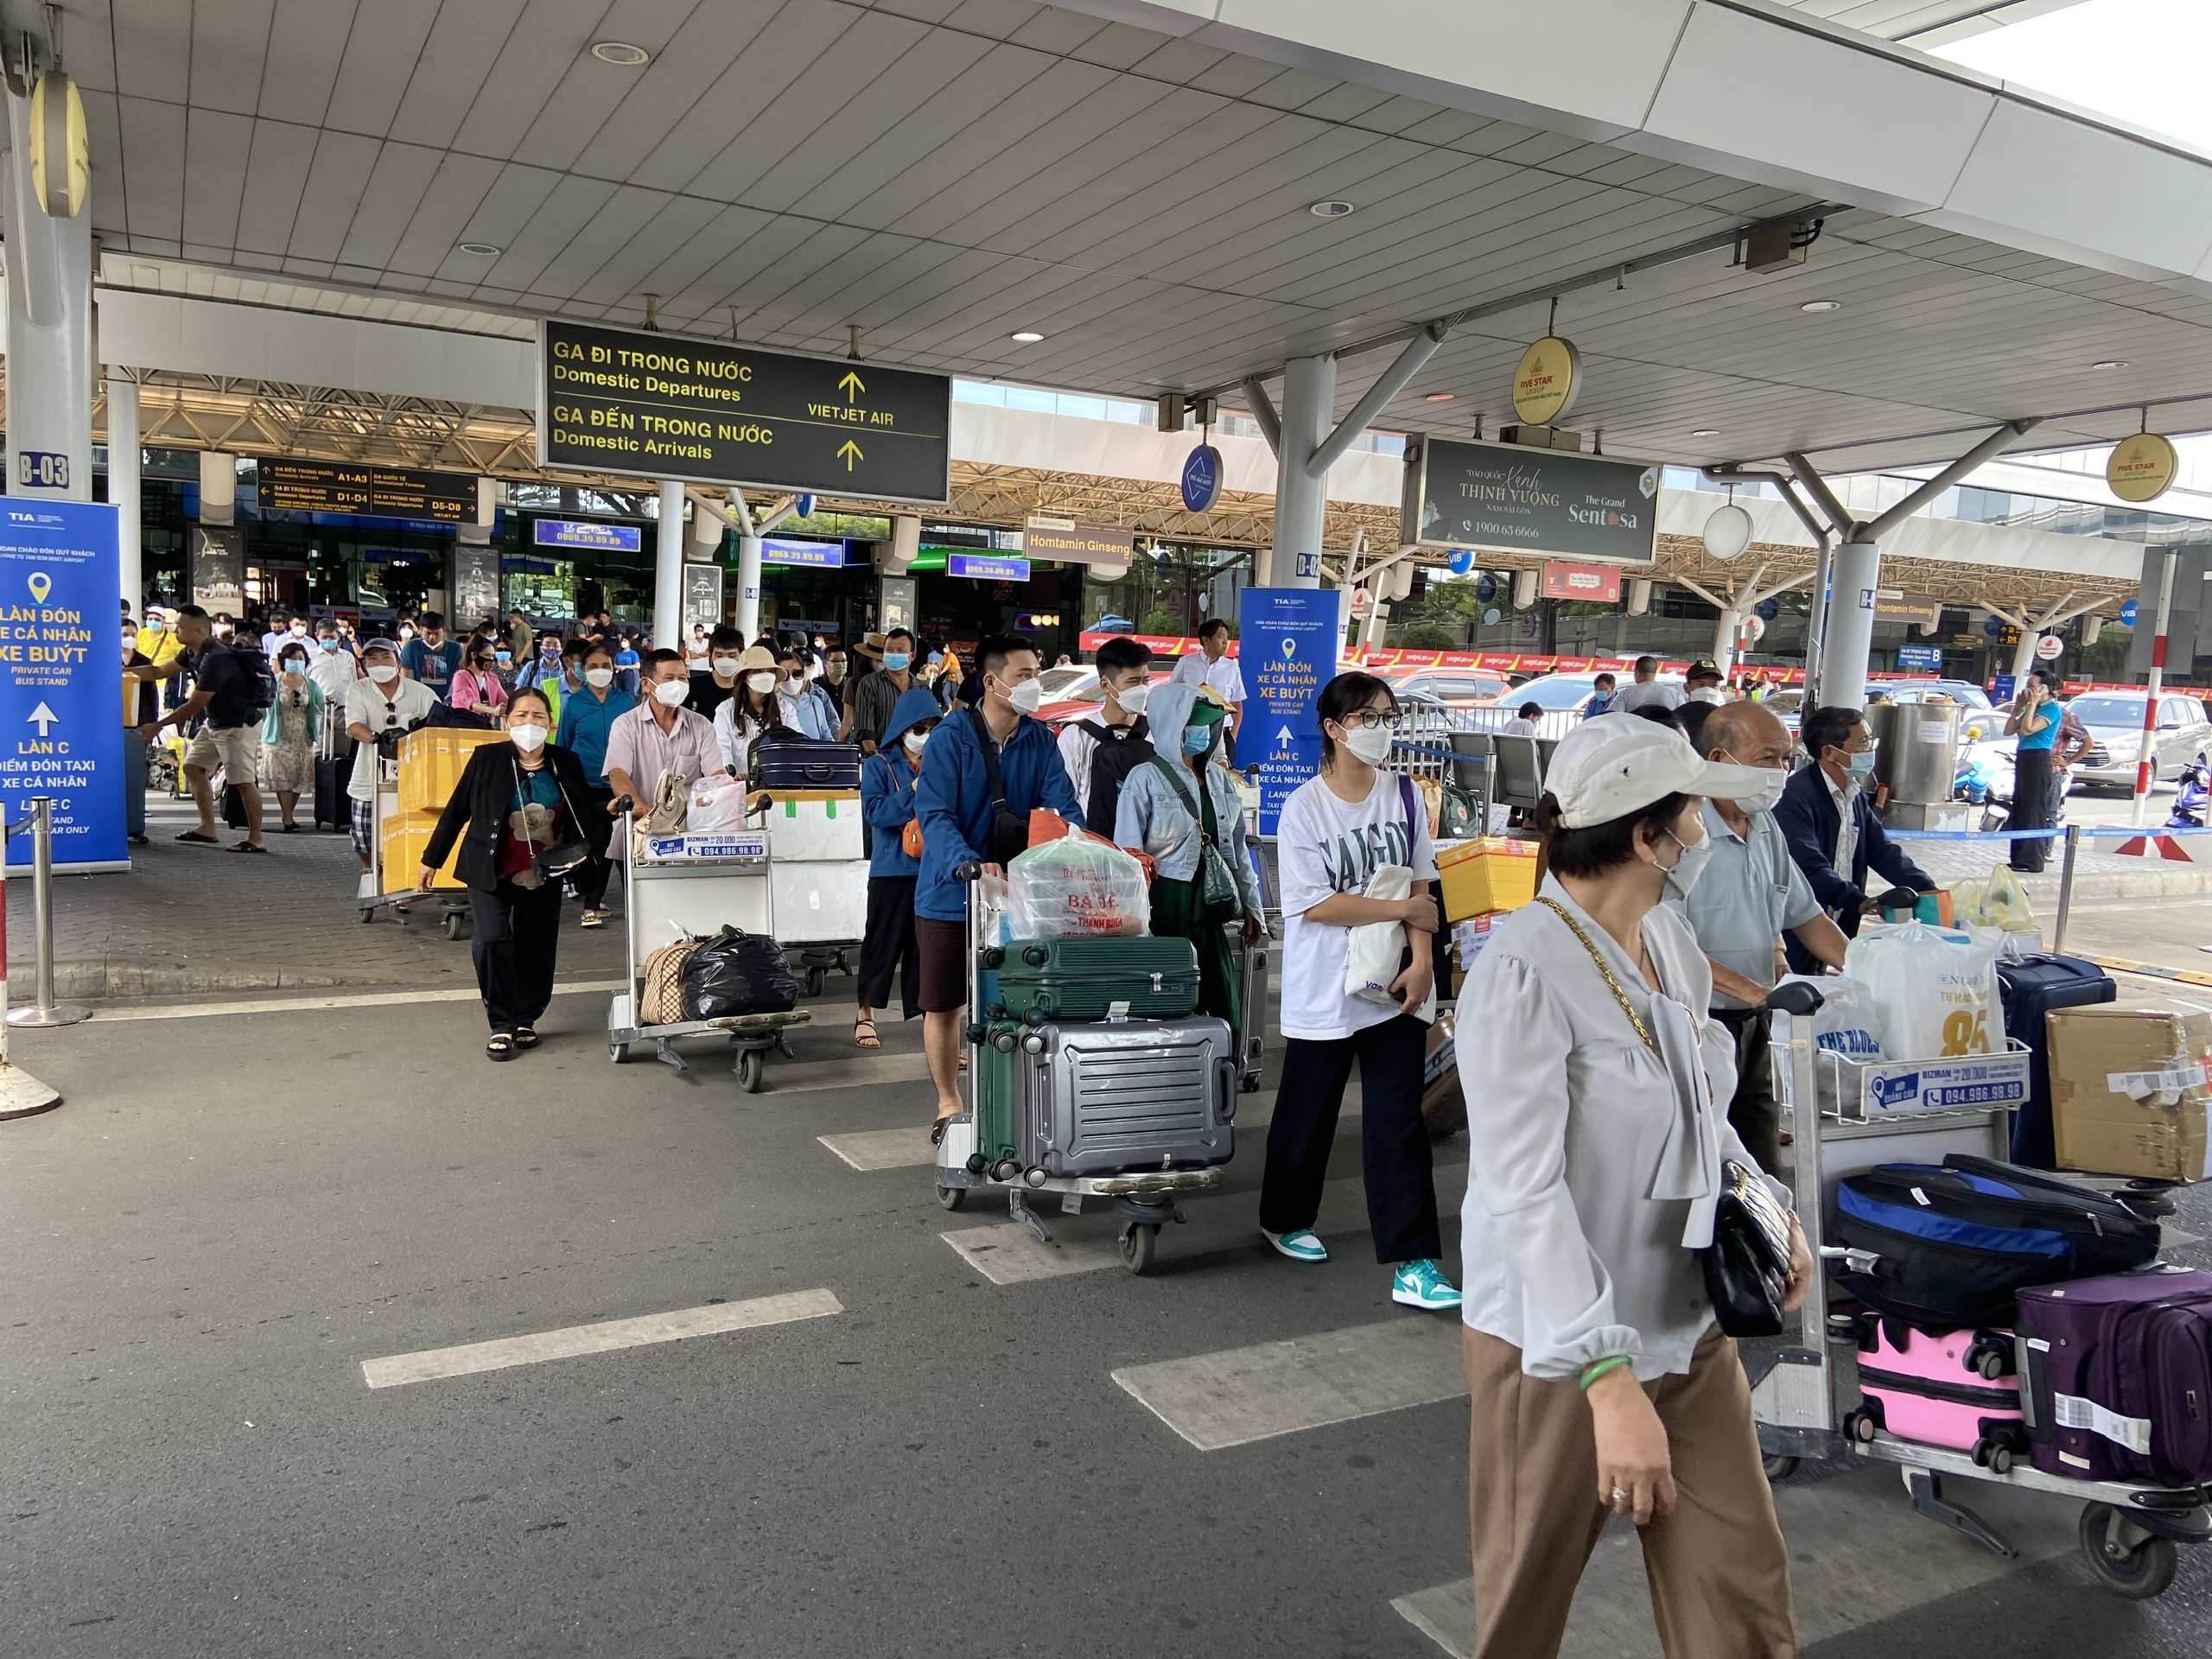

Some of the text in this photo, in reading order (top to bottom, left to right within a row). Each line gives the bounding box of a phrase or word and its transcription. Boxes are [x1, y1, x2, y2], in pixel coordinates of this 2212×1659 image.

[553, 341, 753, 382] GA ĐI TRONG NƯỚC
[554, 365, 741, 402] Domestic Departures
[1521, 376, 1553, 390] FIVE STAR
[1525, 386, 1545, 396] GROUP
[808, 403, 894, 425] VIETJET AIR
[553, 406, 773, 445] GA ĐẾN TRONG NƯỚC
[554, 429, 713, 460] Domestic Arrivals
[20, 454, 68, 486] B-03
[338, 473, 367, 483] A1-A3
[337, 493, 367, 503] D1-D4
[1460, 483, 1560, 506] THỊNH VƯỢNG
[1585, 494, 1625, 508] The Grand
[432, 501, 461, 512] D5-D8
[1503, 505, 1515, 513] SÀI
[1516, 505, 1531, 515] GÒN
[8, 512, 35, 522] TIA
[1475, 521, 1539, 538] 1900 63 6666
[1030, 534, 1130, 556] Homtamin Ginseng
[1449, 553, 1462, 563] VIB
[41, 607, 80, 624] ĐÓN
[1877, 604, 1933, 616] Homtamin Ginseng
[14, 625, 92, 642] CÁ NHÂN
[29, 644, 87, 663] BUÝT
[1933, 649, 1940, 662] B
[11, 666, 50, 675] PRIVATE
[1263, 659, 1312, 673] LÀN ĐÓN
[1257, 673, 1317, 685] XE CÁ NHÂN
[1260, 686, 1314, 699] XE BUÝT
[18, 739, 70, 754] LÀN C
[1269, 750, 1289, 760] LÀN
[31, 758, 61, 772] ĐÓN
[64, 760, 95, 772] TAXI
[1259, 762, 1313, 773] IỂM ĐÓN TAXI
[2, 775, 87, 788] XE CÁ NHÂN
[1271, 774, 1282, 784] CÁ
[20, 798, 71, 810] LE C
[50, 826, 64, 835] AR
[715, 836, 735, 844] 20.000
[704, 847, 760, 855] 094.986.98.98
[1817, 1029, 1879, 1053] THE BLUES
[1923, 1066, 1987, 1081] BIZMAN 20.000
[1946, 1084, 2020, 1103] 094.986.98.98
